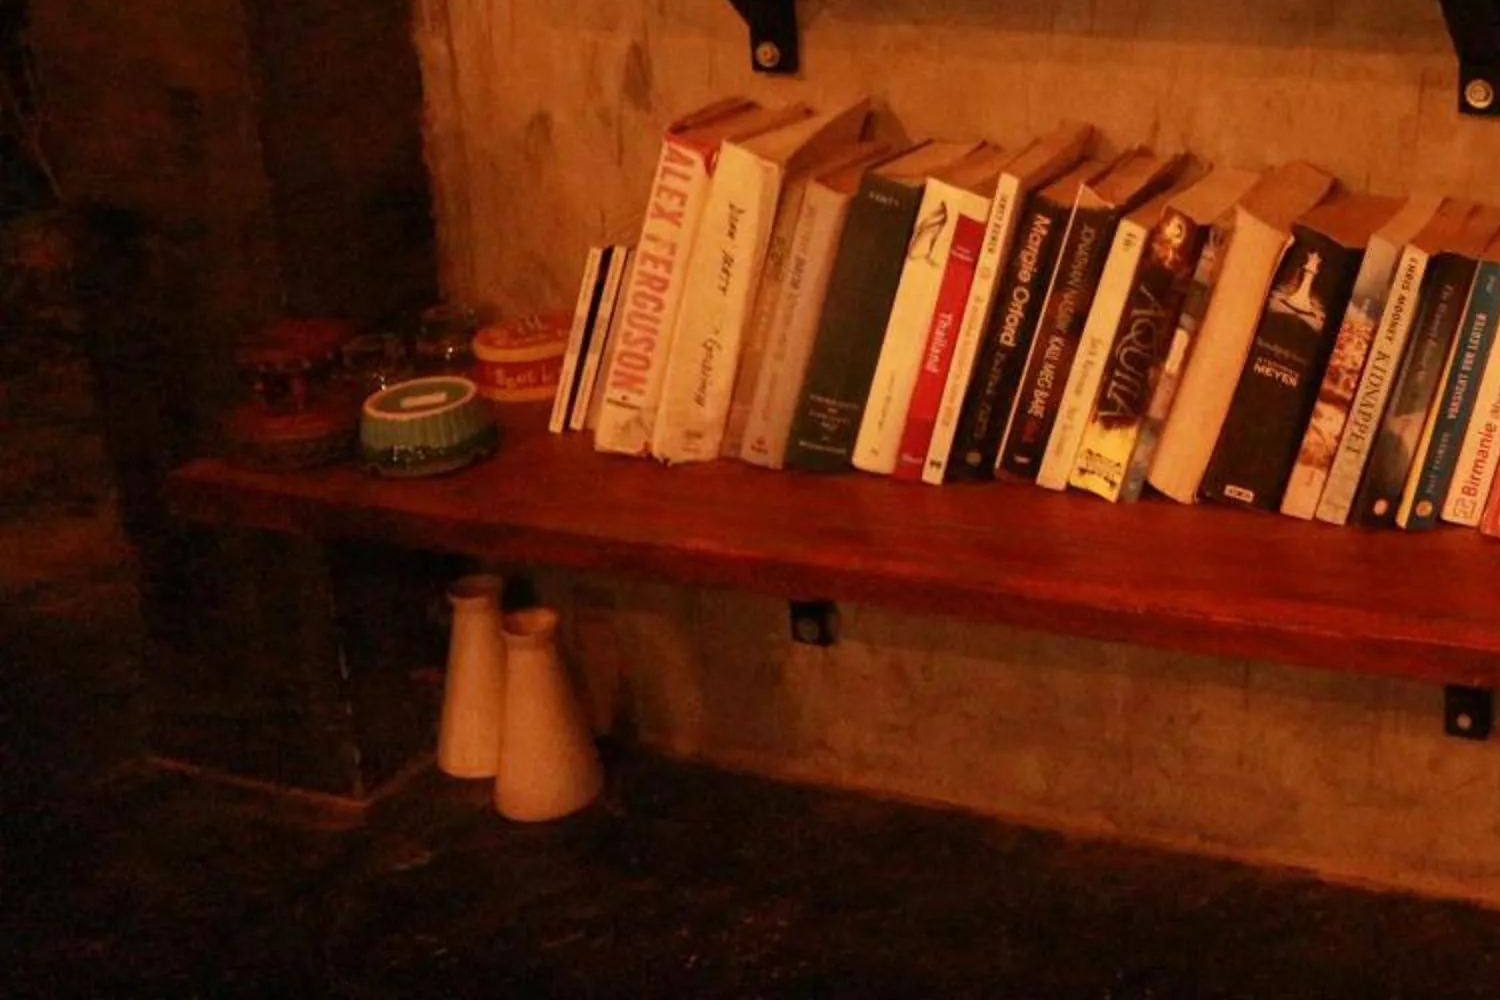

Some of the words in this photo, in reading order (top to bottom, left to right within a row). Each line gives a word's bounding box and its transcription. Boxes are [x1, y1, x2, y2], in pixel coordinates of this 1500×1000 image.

[650, 145, 696, 228] ALEX
[613, 235, 676, 395] FERGUSON
[999, 285, 1030, 347] Orford
[1102, 285, 1163, 428] AQUILA
[1345, 351, 1389, 456] KIDNAPPET
[1461, 422, 1497, 497] Birmanie
